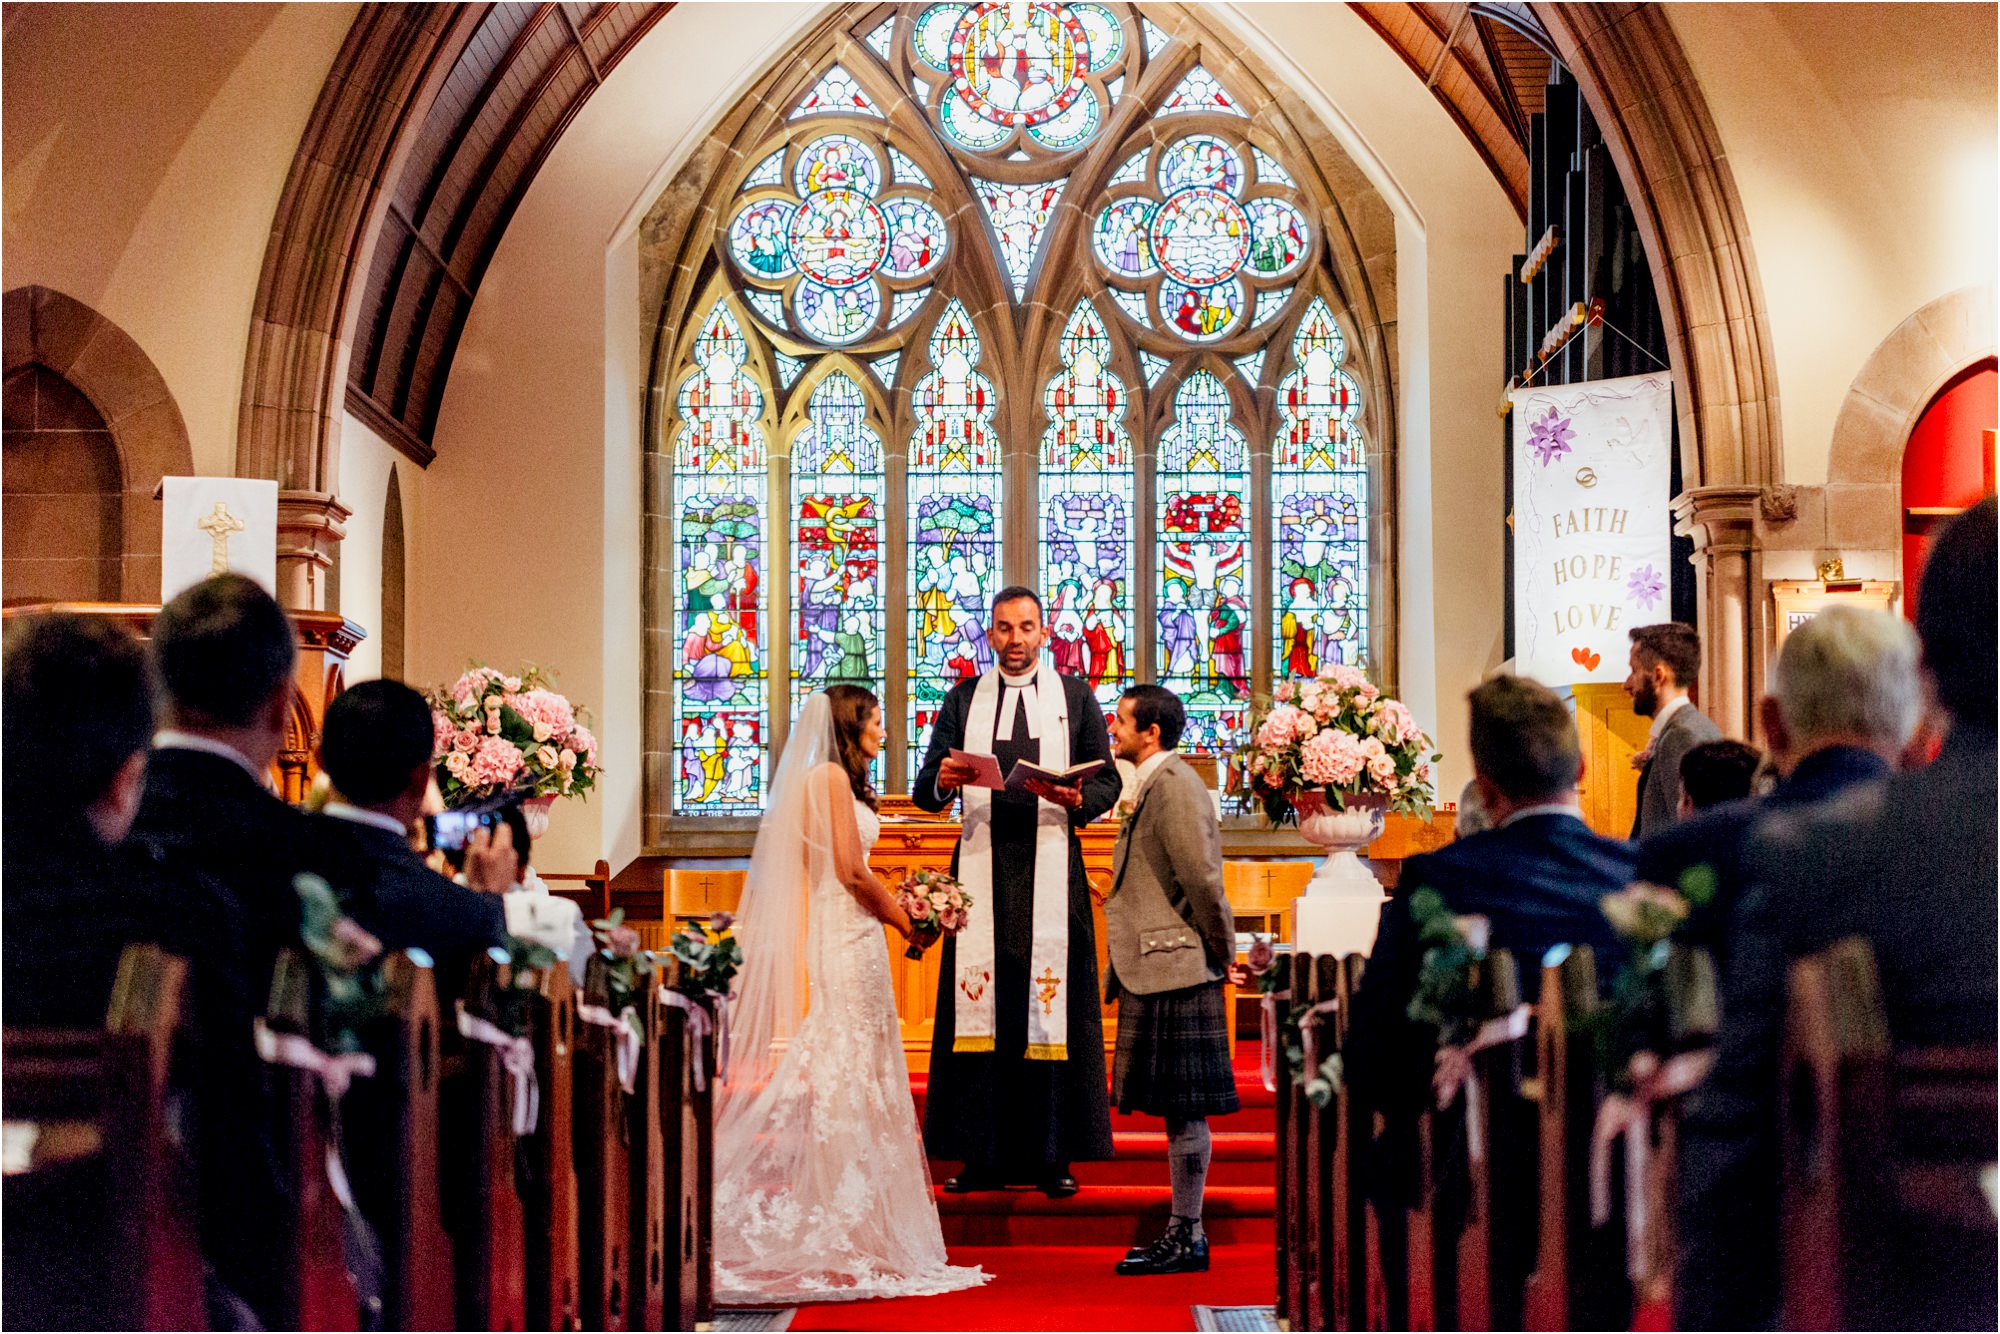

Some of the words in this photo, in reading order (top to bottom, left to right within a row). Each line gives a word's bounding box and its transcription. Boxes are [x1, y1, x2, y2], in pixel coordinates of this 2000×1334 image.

[1552, 507, 1629, 539] FAITH
[1553, 554, 1623, 586] HOPE
[1553, 604, 1622, 636] LOVE
